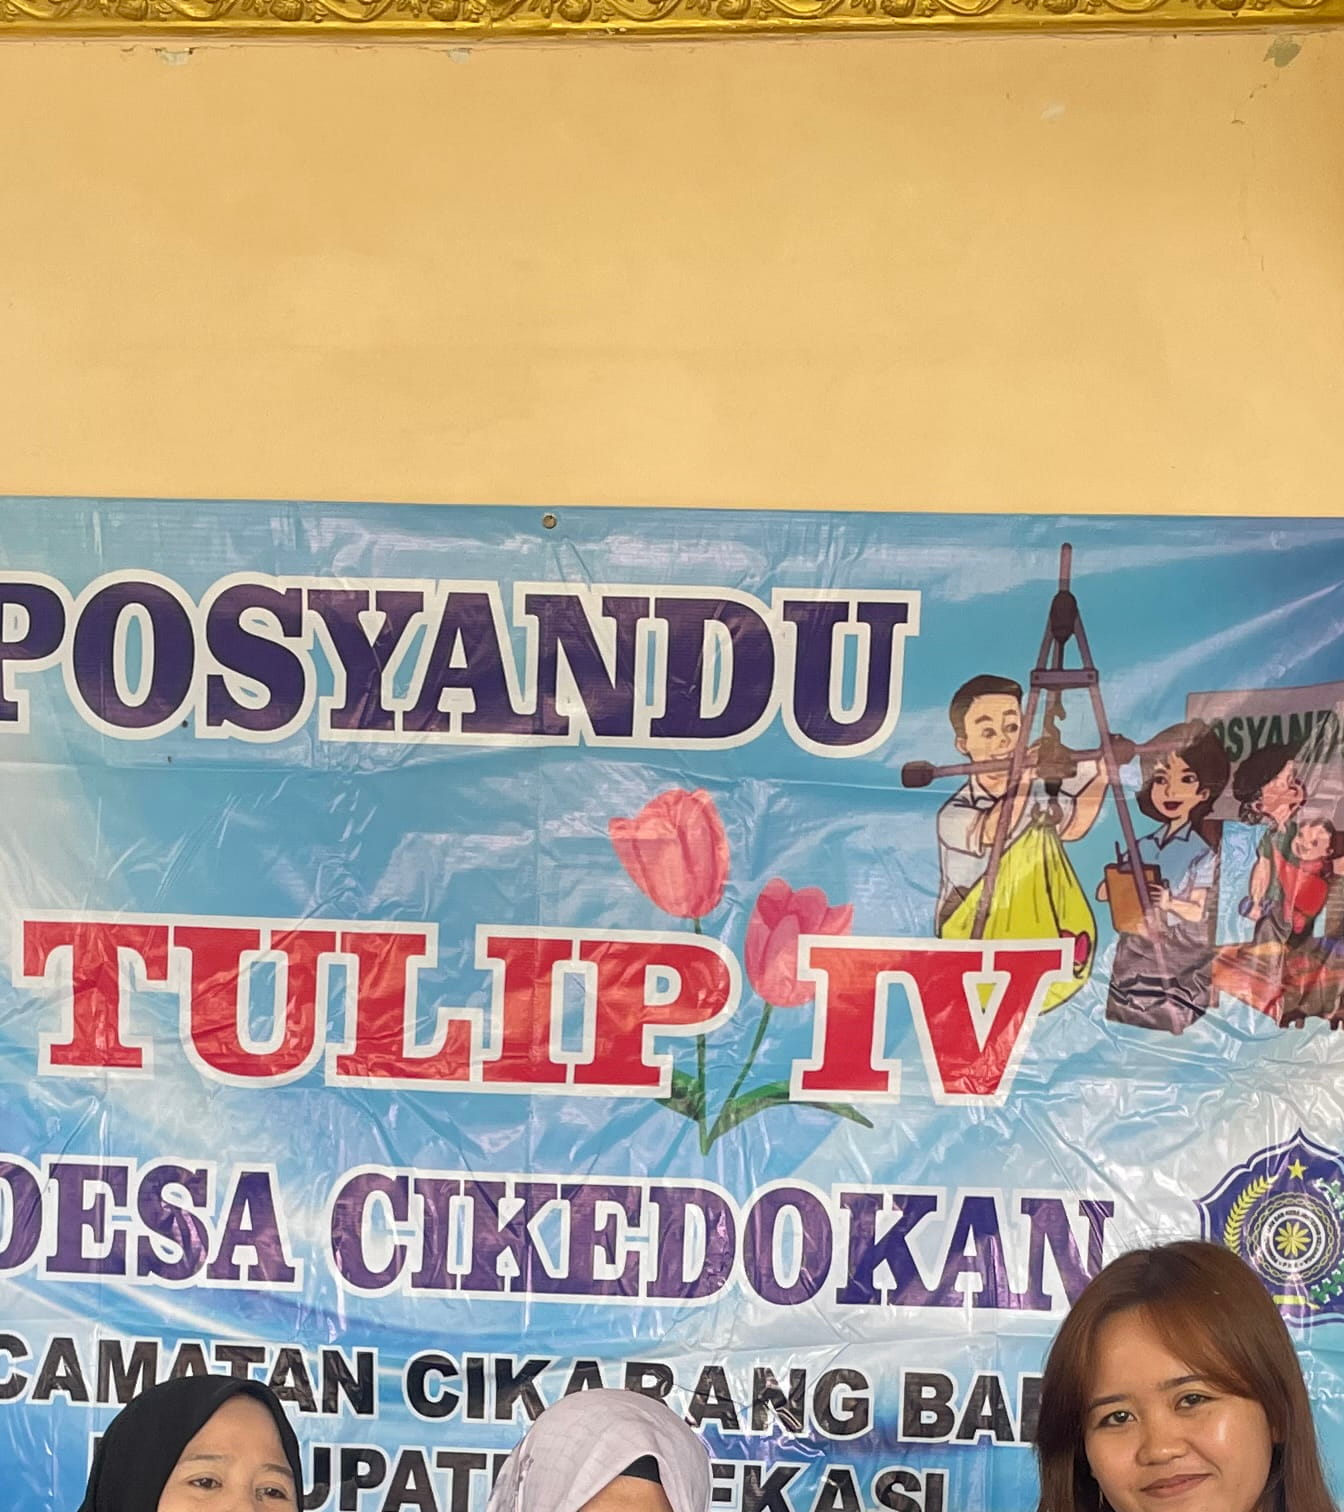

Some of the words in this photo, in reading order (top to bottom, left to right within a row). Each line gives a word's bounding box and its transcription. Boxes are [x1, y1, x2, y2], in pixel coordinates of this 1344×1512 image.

[20, 918, 731, 1087] TULIP
[798, 945, 1064, 1098] IV
[330, 1170, 1115, 1312] CIKEDOKAN
